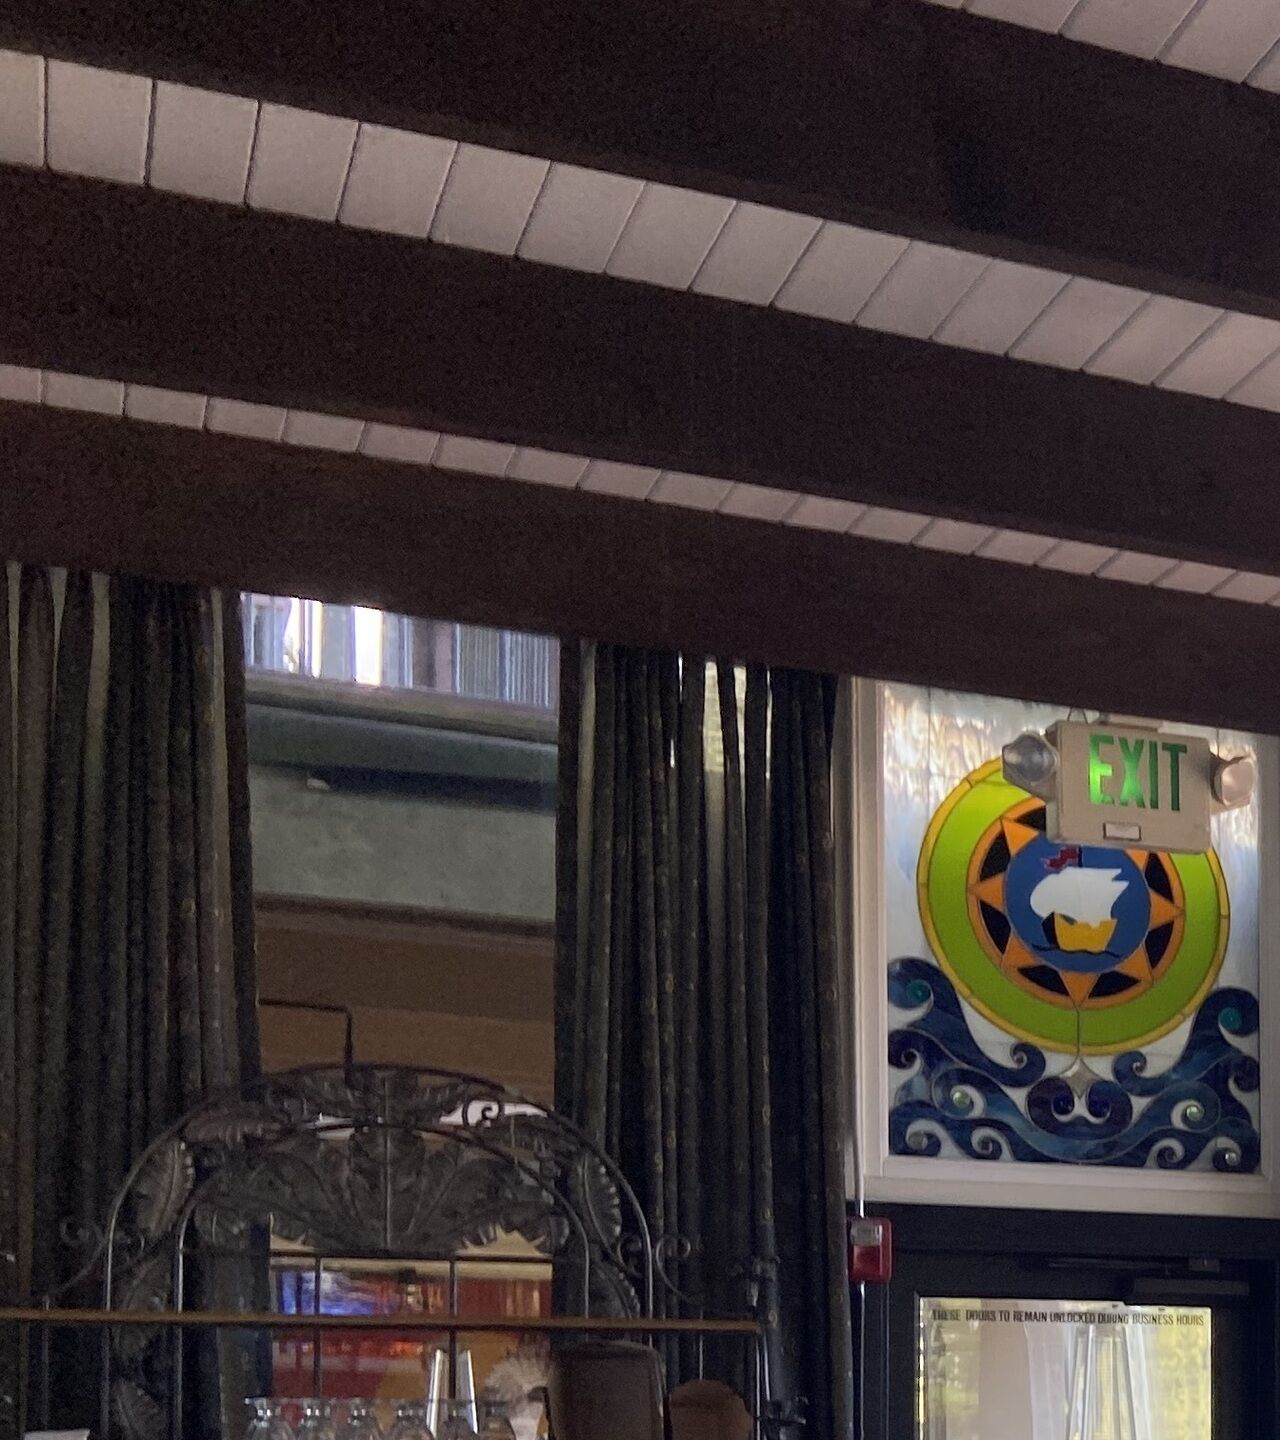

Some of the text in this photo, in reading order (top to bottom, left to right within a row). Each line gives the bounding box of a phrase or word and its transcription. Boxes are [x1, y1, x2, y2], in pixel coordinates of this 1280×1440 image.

[1089, 733, 1188, 812] EXIT
[932, 1309, 1204, 1326] THESE DOORS TO REMAIN UNLOCKED DURING BUSINESS HOURS
